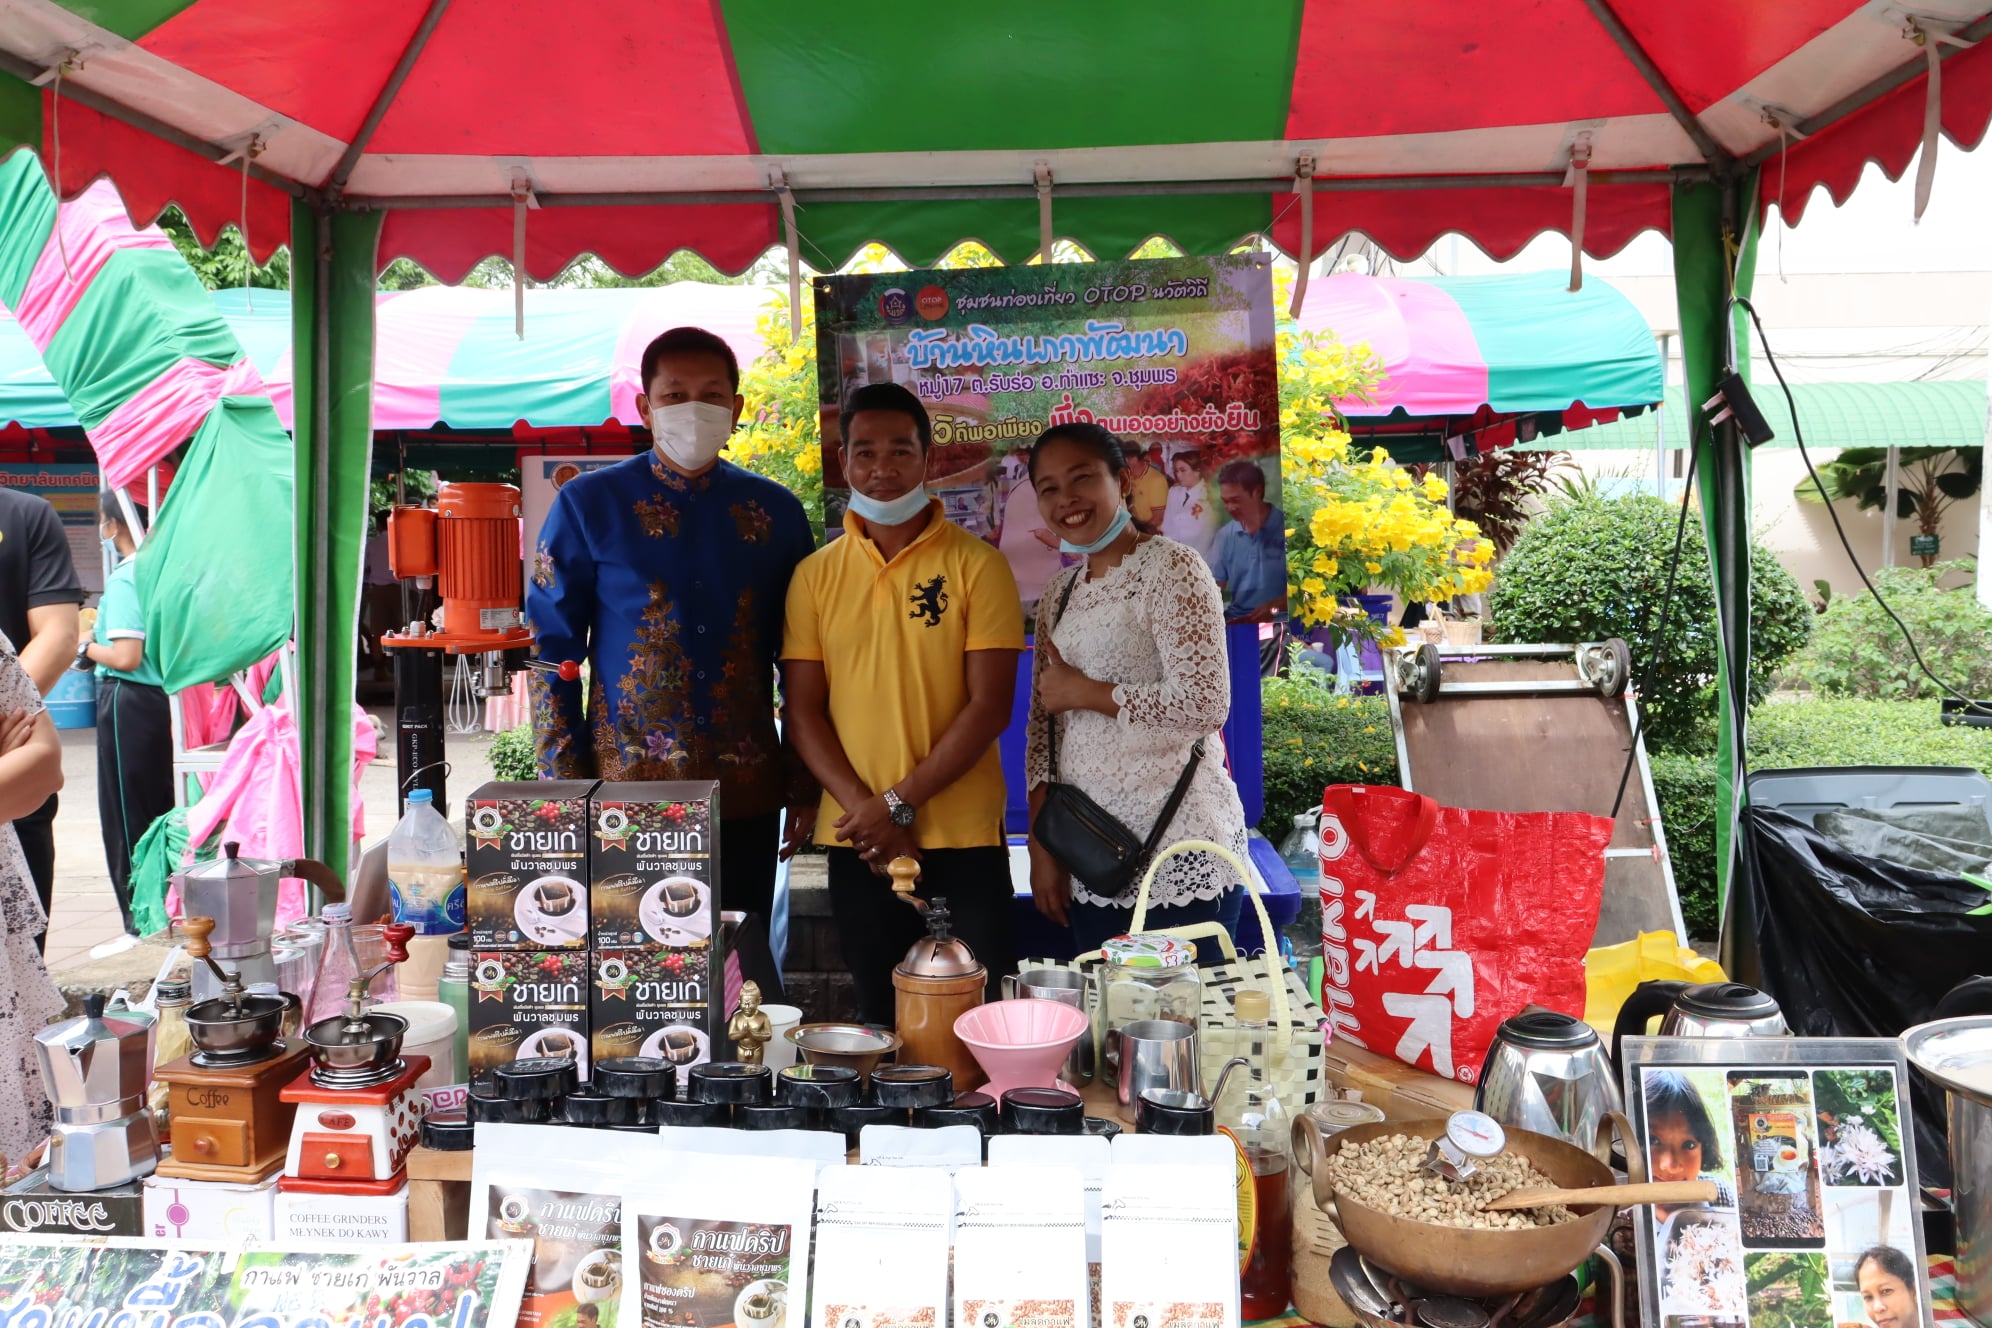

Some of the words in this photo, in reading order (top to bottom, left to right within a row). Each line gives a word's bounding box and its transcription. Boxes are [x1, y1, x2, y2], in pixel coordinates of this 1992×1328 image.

[955, 281, 1076, 315] ชุมชนท่องเที่ยว
[1084, 284, 1145, 304] OTOP
[918, 373, 965, 401] หมู่17
[971, 370, 1035, 393] ต.รับร่อ
[1041, 369, 1106, 391] อ.ท่าแซะ
[1111, 367, 1178, 391] จ.ชุมพร
[1319, 813, 1369, 1049] makro
[186, 1086, 230, 1110] Coffee
[3, 1198, 116, 1233] COFFEE
[289, 1213, 331, 1225] COFFEE
[332, 1214, 388, 1225] GRINDERS
[289, 1227, 336, 1239] MŁYNEK
[338, 1228, 355, 1239] DO
[356, 1228, 390, 1239] KAWY
[691, 1226, 787, 1255] กาแฟดริป
[377, 1265, 442, 1287] พันวาล
